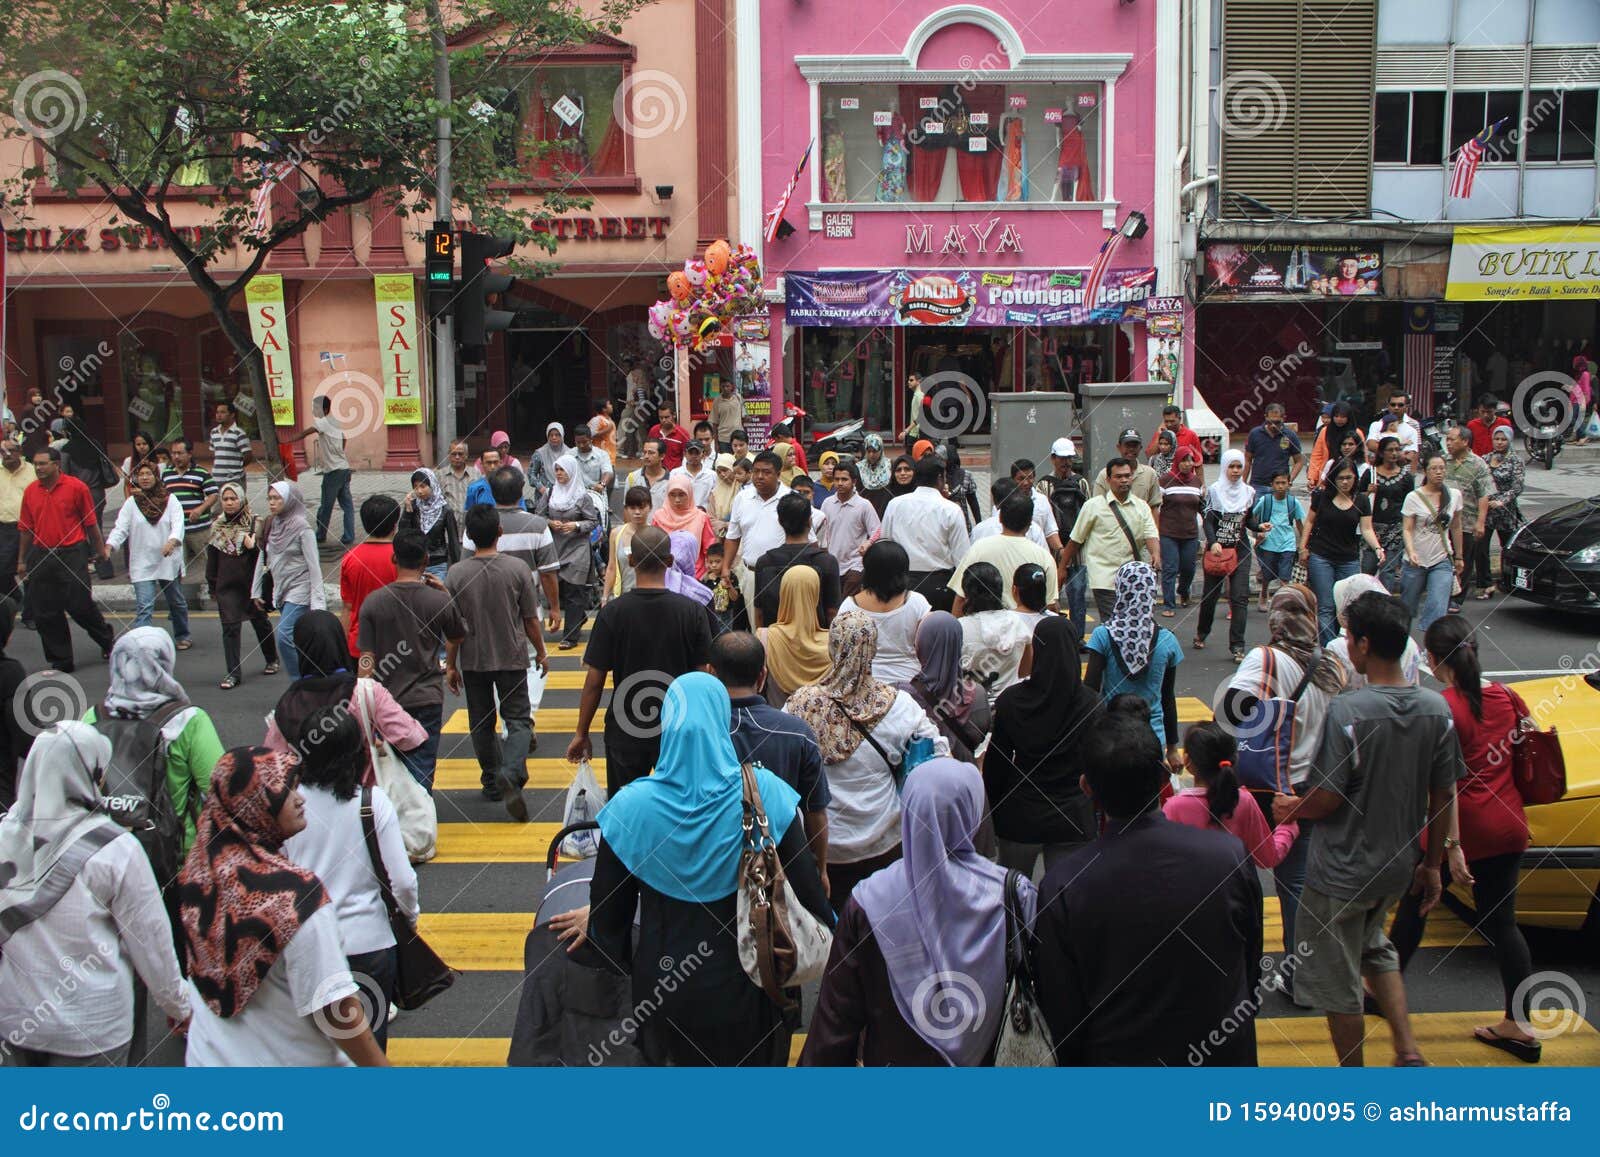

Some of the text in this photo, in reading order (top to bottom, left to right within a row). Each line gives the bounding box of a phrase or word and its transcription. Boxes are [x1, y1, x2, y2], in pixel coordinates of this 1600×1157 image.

[1044, 112, 1062, 121] 40%
[826, 214, 853, 225] GALERI
[530, 216, 670, 240] STREET
[827, 226, 853, 238] FABRIK
[904, 217, 1024, 253] MAYA
[436, 234, 450, 254] 12
[1269, 243, 1292, 252] Tahun
[1478, 248, 1579, 279] BUTIK
[909, 284, 958, 299] JUALAN
[988, 286, 1086, 307] Potongan
[1485, 286, 1520, 297] Songket
[1529, 285, 1551, 295] Butik
[790, 308, 890, 317] FABRIK KREATIF MALAYSIA
[1147, 299, 1182, 311] MAYA
[259, 305, 285, 398] SALE
[388, 305, 412, 397] SALE
